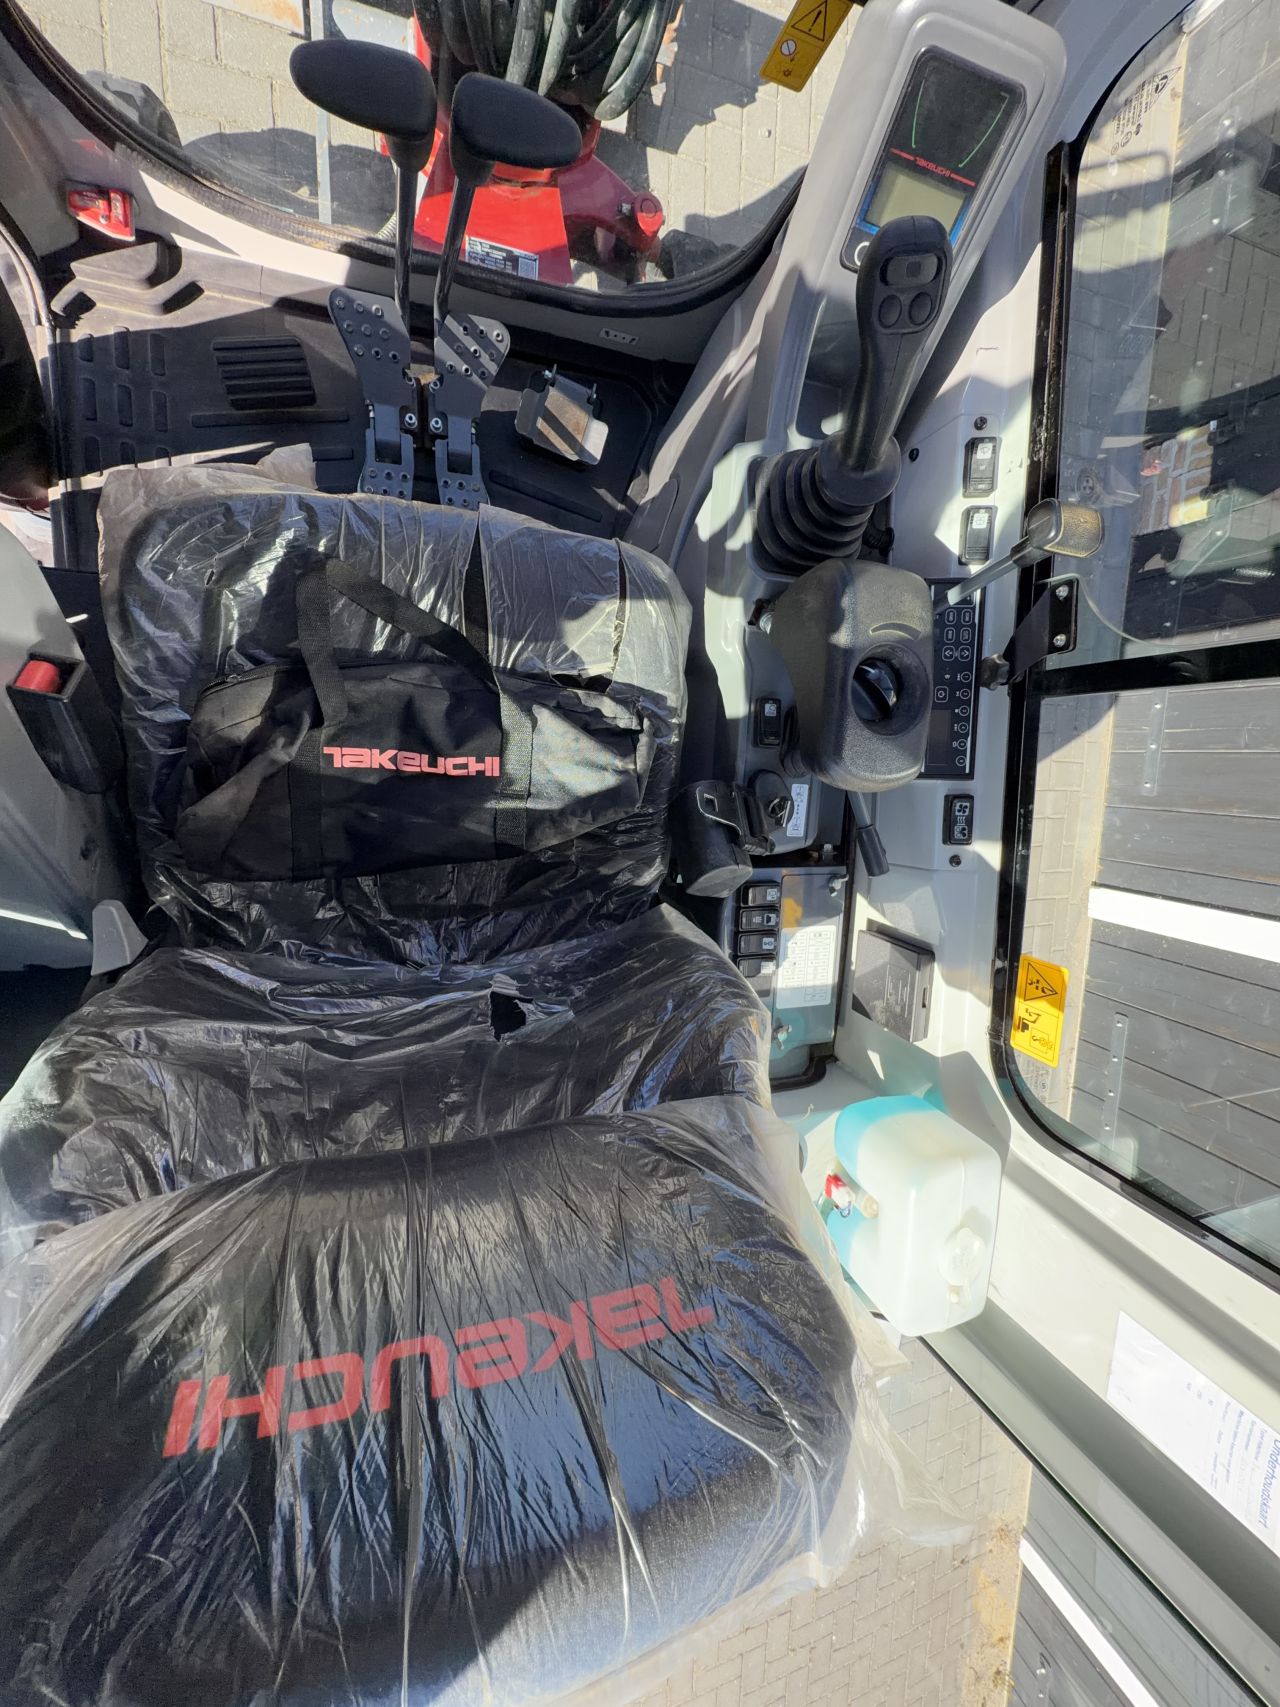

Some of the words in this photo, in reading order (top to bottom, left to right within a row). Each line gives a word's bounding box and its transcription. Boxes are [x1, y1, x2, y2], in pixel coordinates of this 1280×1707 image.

[915, 156, 951, 177] TAKEUCHI
[323, 746, 500, 776] TAKEUCHI
[162, 1277, 717, 1458] TAKEUCHI
